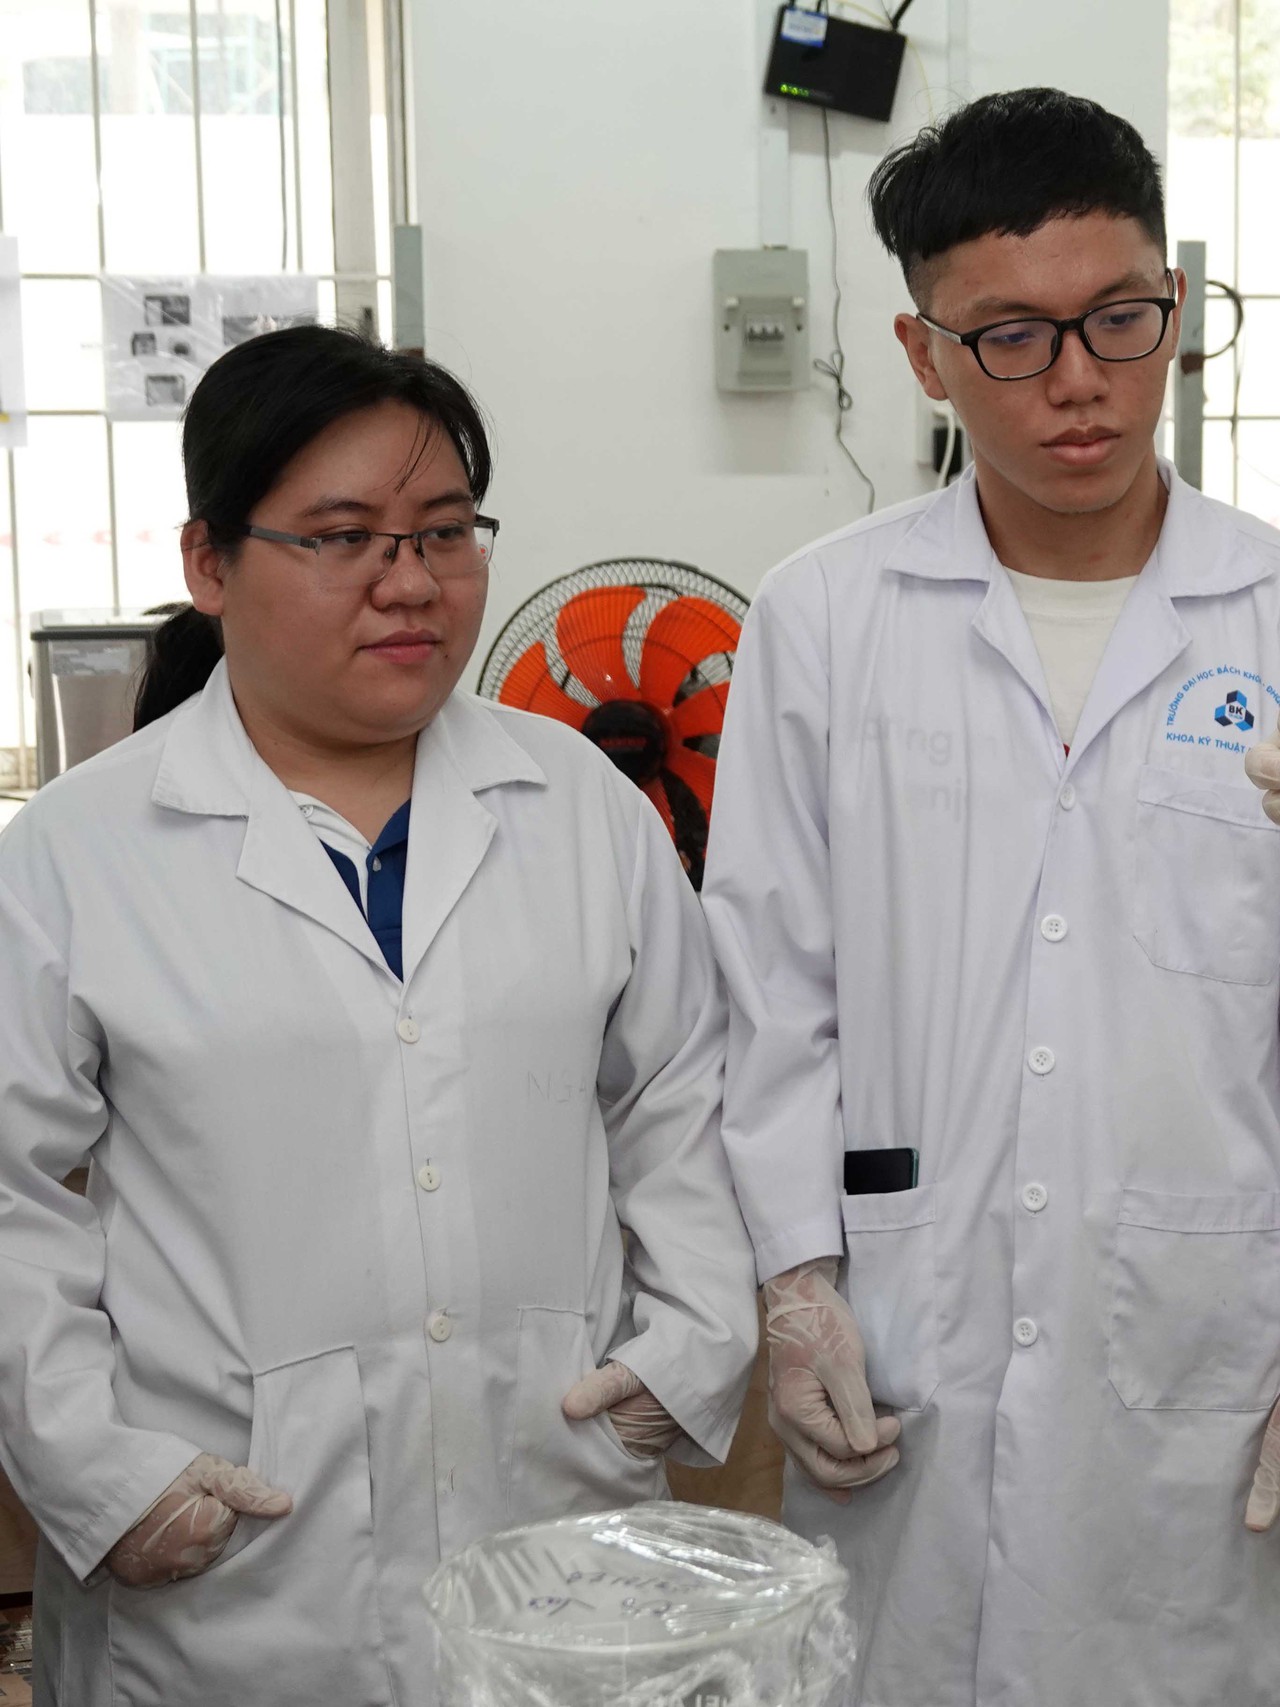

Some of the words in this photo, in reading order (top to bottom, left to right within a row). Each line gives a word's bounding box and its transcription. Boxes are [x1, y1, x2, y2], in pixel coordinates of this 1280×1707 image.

[1182, 677, 1197, 692] ĐẠI
[1196, 669, 1215, 681] HỌC
[1216, 664, 1241, 675] BÁCH
[1228, 704, 1243, 715] BK
[1166, 732, 1195, 743] KHOA
[1215, 739, 1246, 754] THUẬT
